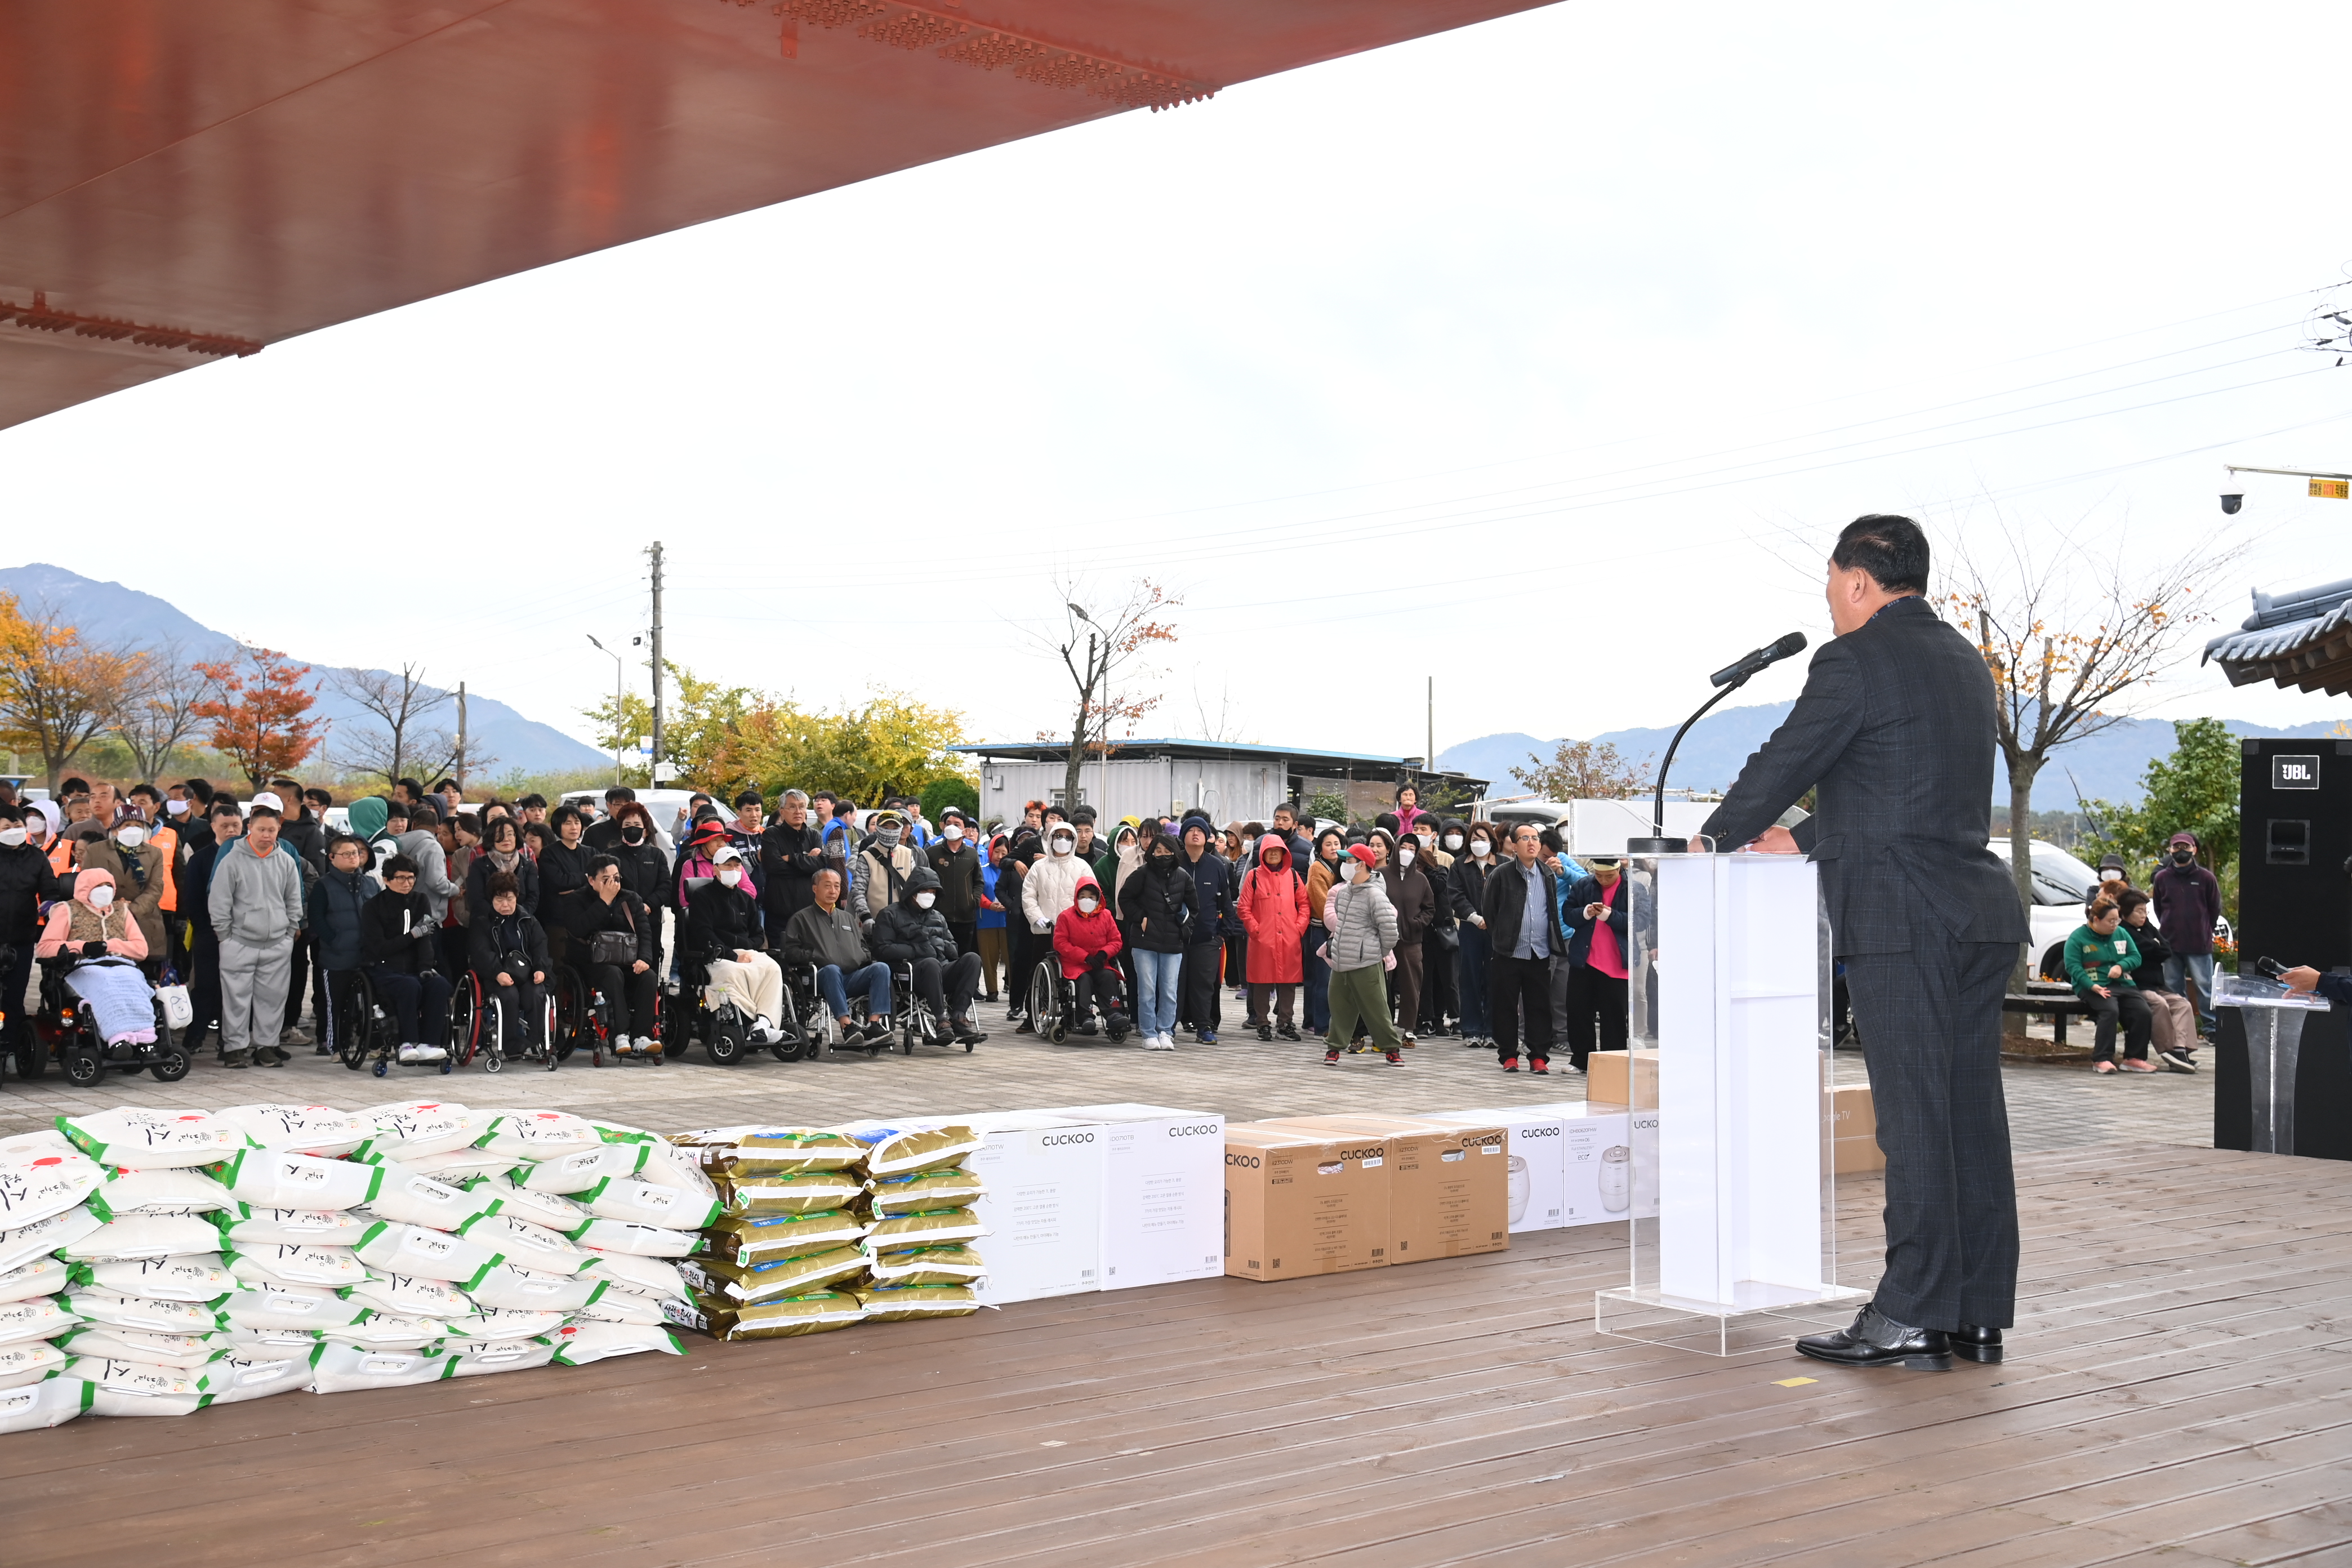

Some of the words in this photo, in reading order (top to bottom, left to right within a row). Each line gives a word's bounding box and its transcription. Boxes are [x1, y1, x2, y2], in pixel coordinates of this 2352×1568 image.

[2323, 483, 2335, 496] CCTV
[2282, 765, 2311, 780] JBL
[1842, 1111, 1850, 1120] TV
[1169, 1124, 1218, 1137] CUCKOO
[1634, 1119, 1659, 1129] UCKO
[1522, 1127, 1560, 1138] CUCKOO
[1042, 1133, 1094, 1146] CUCKOO
[1462, 1135, 1502, 1147] CUCKOO
[1340, 1147, 1384, 1160] CUCKOO
[1225, 1153, 1260, 1169] CKOO
